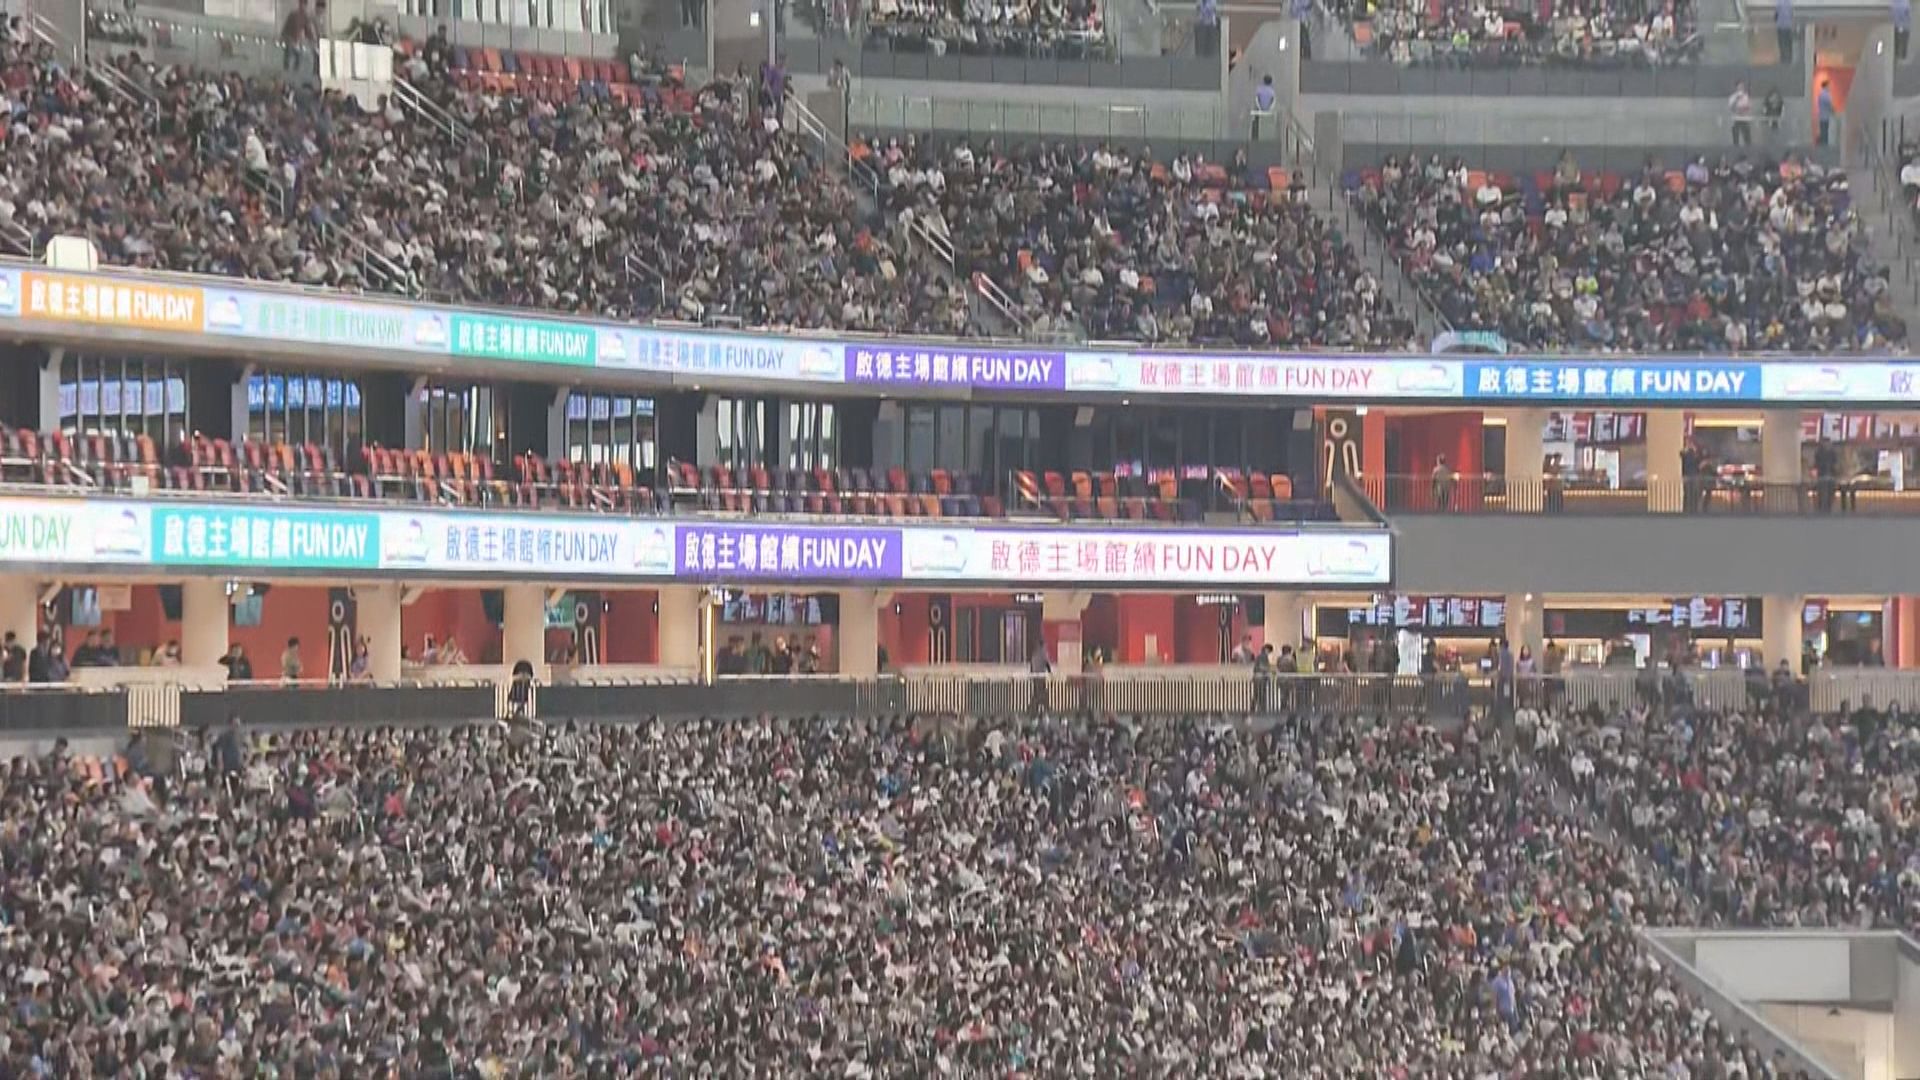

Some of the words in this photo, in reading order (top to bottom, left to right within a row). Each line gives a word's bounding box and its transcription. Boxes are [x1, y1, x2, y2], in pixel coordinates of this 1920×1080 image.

[566, 331, 589, 358] DAY
[726, 344, 753, 369] FUN
[757, 347, 784, 369] DAY
[972, 356, 1011, 382] FUN
[1014, 358, 1052, 383] DAY
[1285, 366, 1326, 389] FUN
[1331, 367, 1374, 390] DAY
[1641, 370, 1690, 392] FUN
[1695, 371, 1745, 393] DAY
[32, 513, 72, 551] DAY
[293, 521, 329, 557] FUN
[332, 523, 368, 558] DAY
[555, 531, 585, 561] FUN
[588, 532, 618, 561] DAY
[803, 537, 840, 569] FUN
[843, 537, 887, 569] DAY
[1163, 544, 1214, 572] FUN
[1222, 545, 1277, 572] DAY
